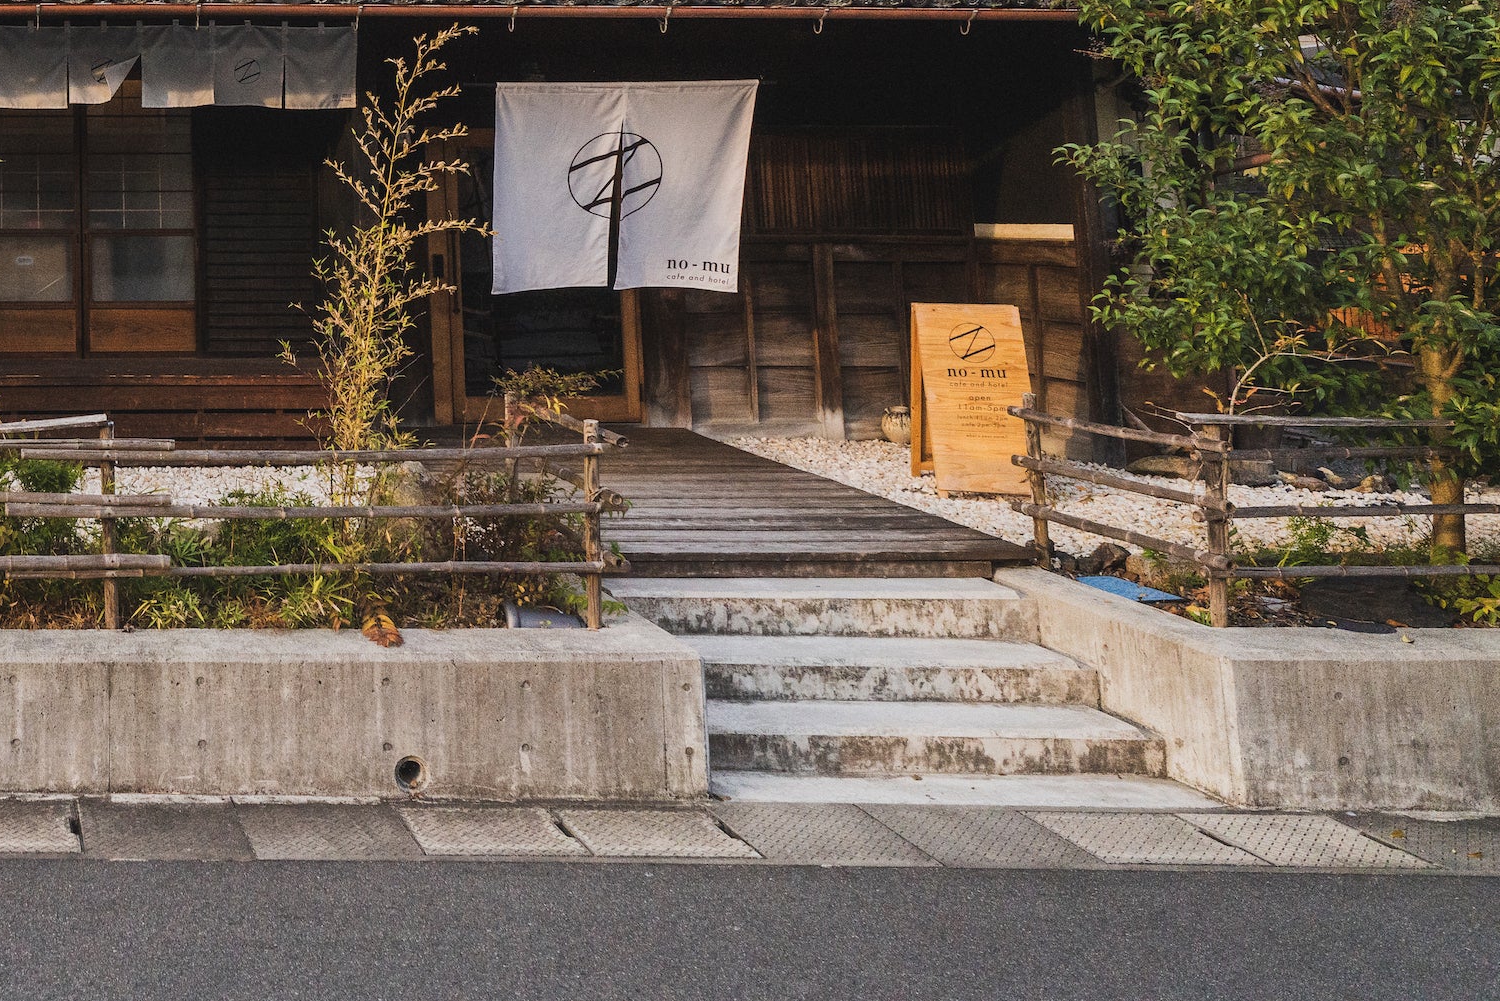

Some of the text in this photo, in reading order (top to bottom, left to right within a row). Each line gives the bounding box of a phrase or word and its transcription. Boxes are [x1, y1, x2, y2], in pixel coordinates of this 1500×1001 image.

[667, 259, 730, 274] no-mu
[708, 276, 729, 285] hotel
[947, 368, 1007, 378] no-mu
[957, 403, 1006, 412] 11am-5pm
